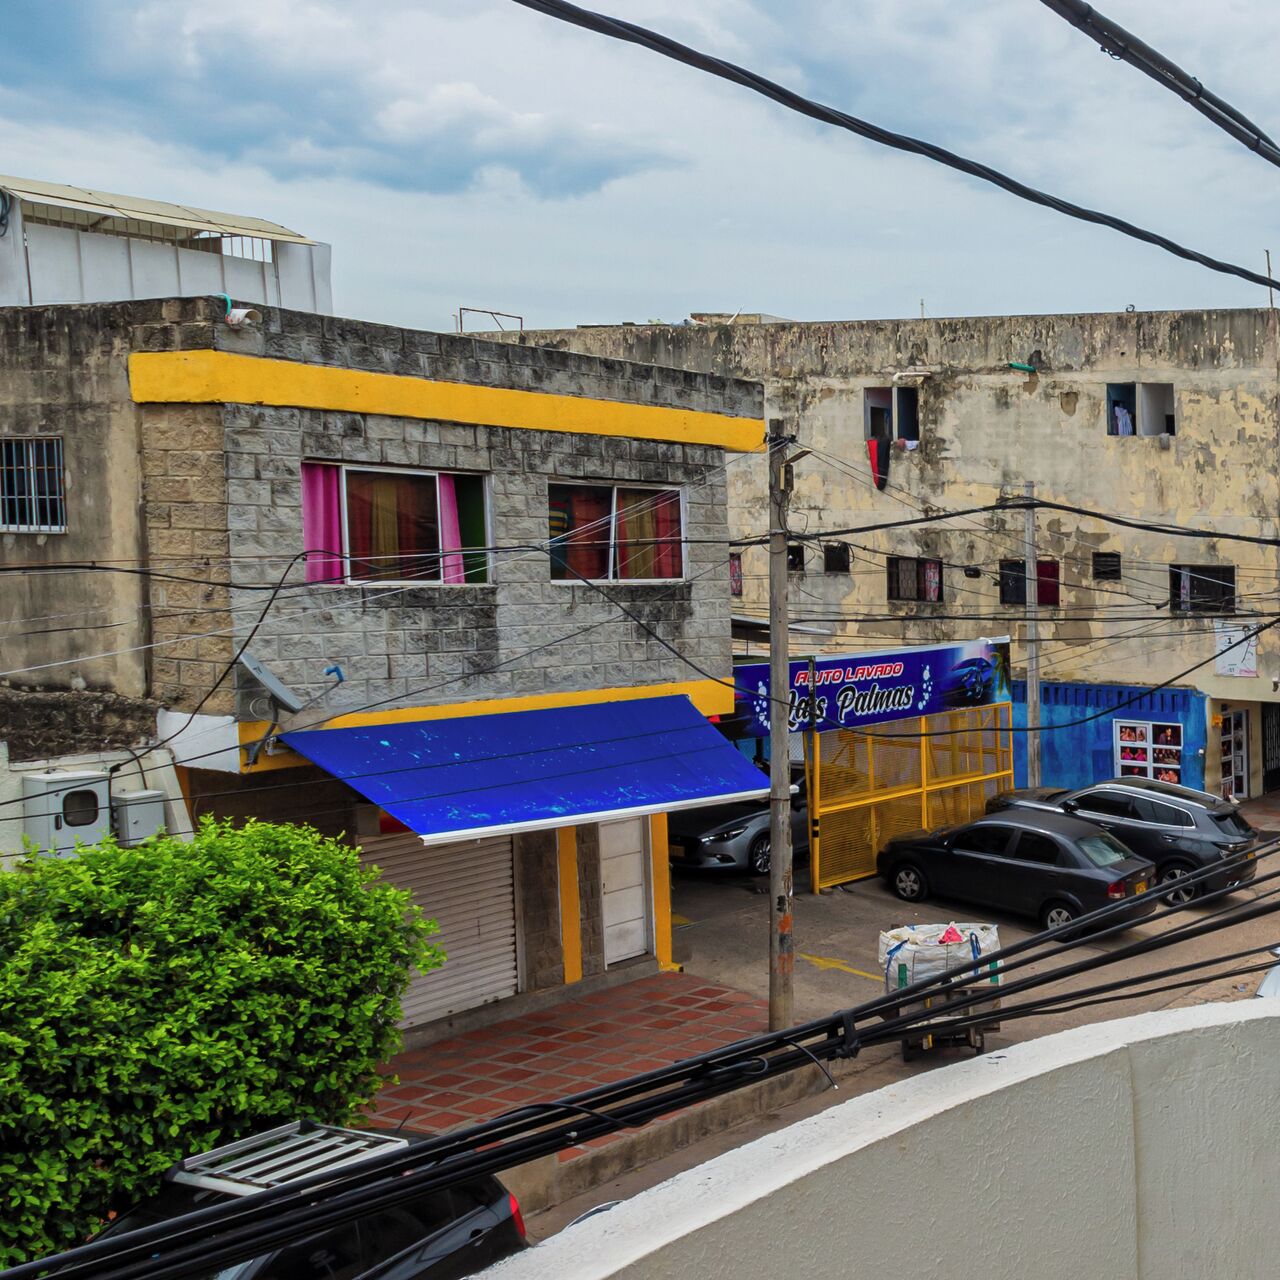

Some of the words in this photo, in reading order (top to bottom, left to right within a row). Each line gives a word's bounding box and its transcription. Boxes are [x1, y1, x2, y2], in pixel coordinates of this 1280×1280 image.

[844, 661, 904, 681] LAVADO
[787, 688, 828, 731] Las
[836, 682, 915, 723] Palmas
